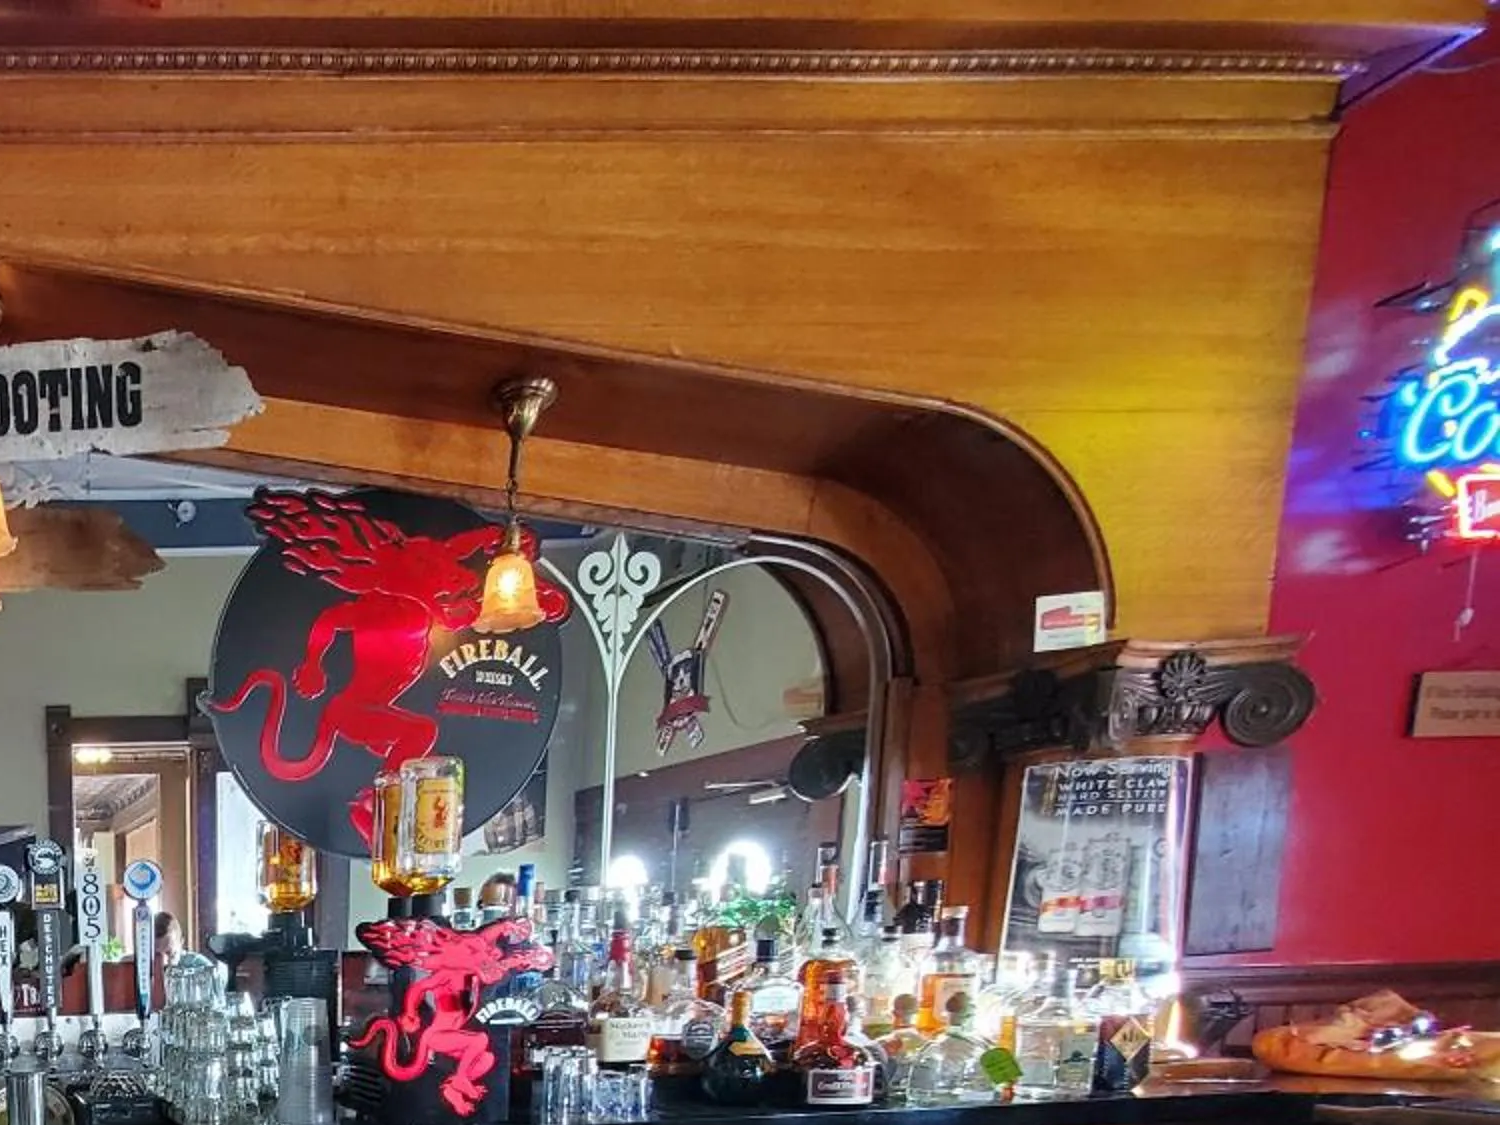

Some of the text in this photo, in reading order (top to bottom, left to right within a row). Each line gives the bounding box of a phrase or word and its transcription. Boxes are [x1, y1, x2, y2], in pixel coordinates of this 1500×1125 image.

[439, 638, 549, 692] FIREBALL
[1058, 777, 1168, 792] WHITE CLAW
[1055, 803, 1167, 817] MADE PURE
[82, 873, 101, 939] 805
